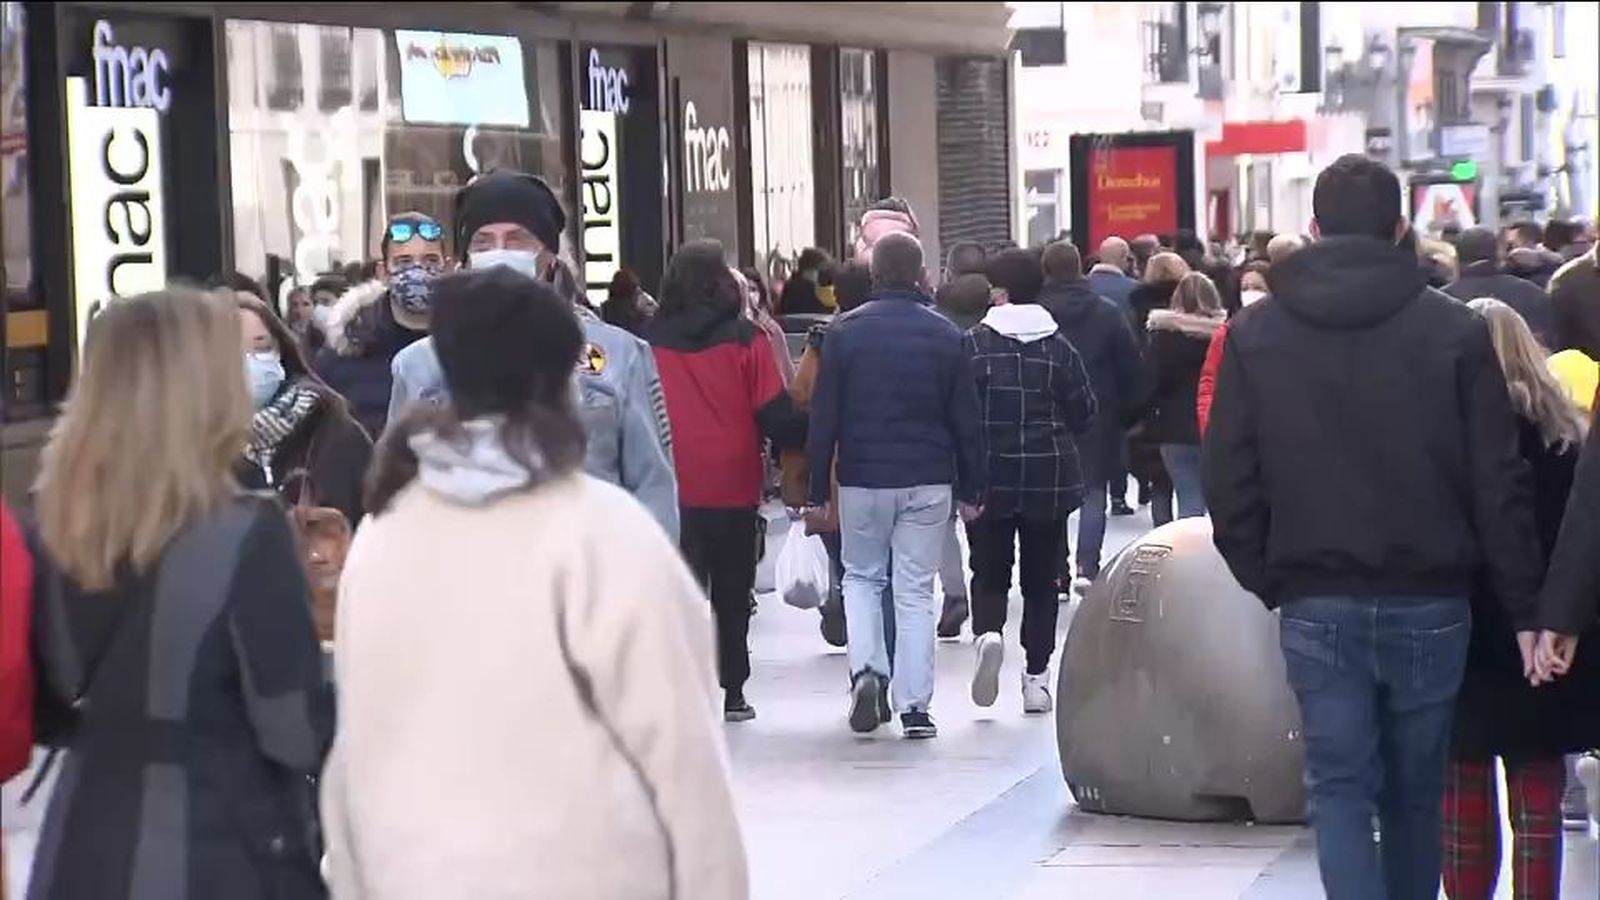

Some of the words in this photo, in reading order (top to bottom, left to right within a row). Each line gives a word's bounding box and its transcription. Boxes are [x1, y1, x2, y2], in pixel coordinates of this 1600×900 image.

[92, 19, 171, 110] fnac
[588, 48, 629, 115] fnac
[685, 100, 730, 192] fnac
[94, 127, 153, 302] nac
